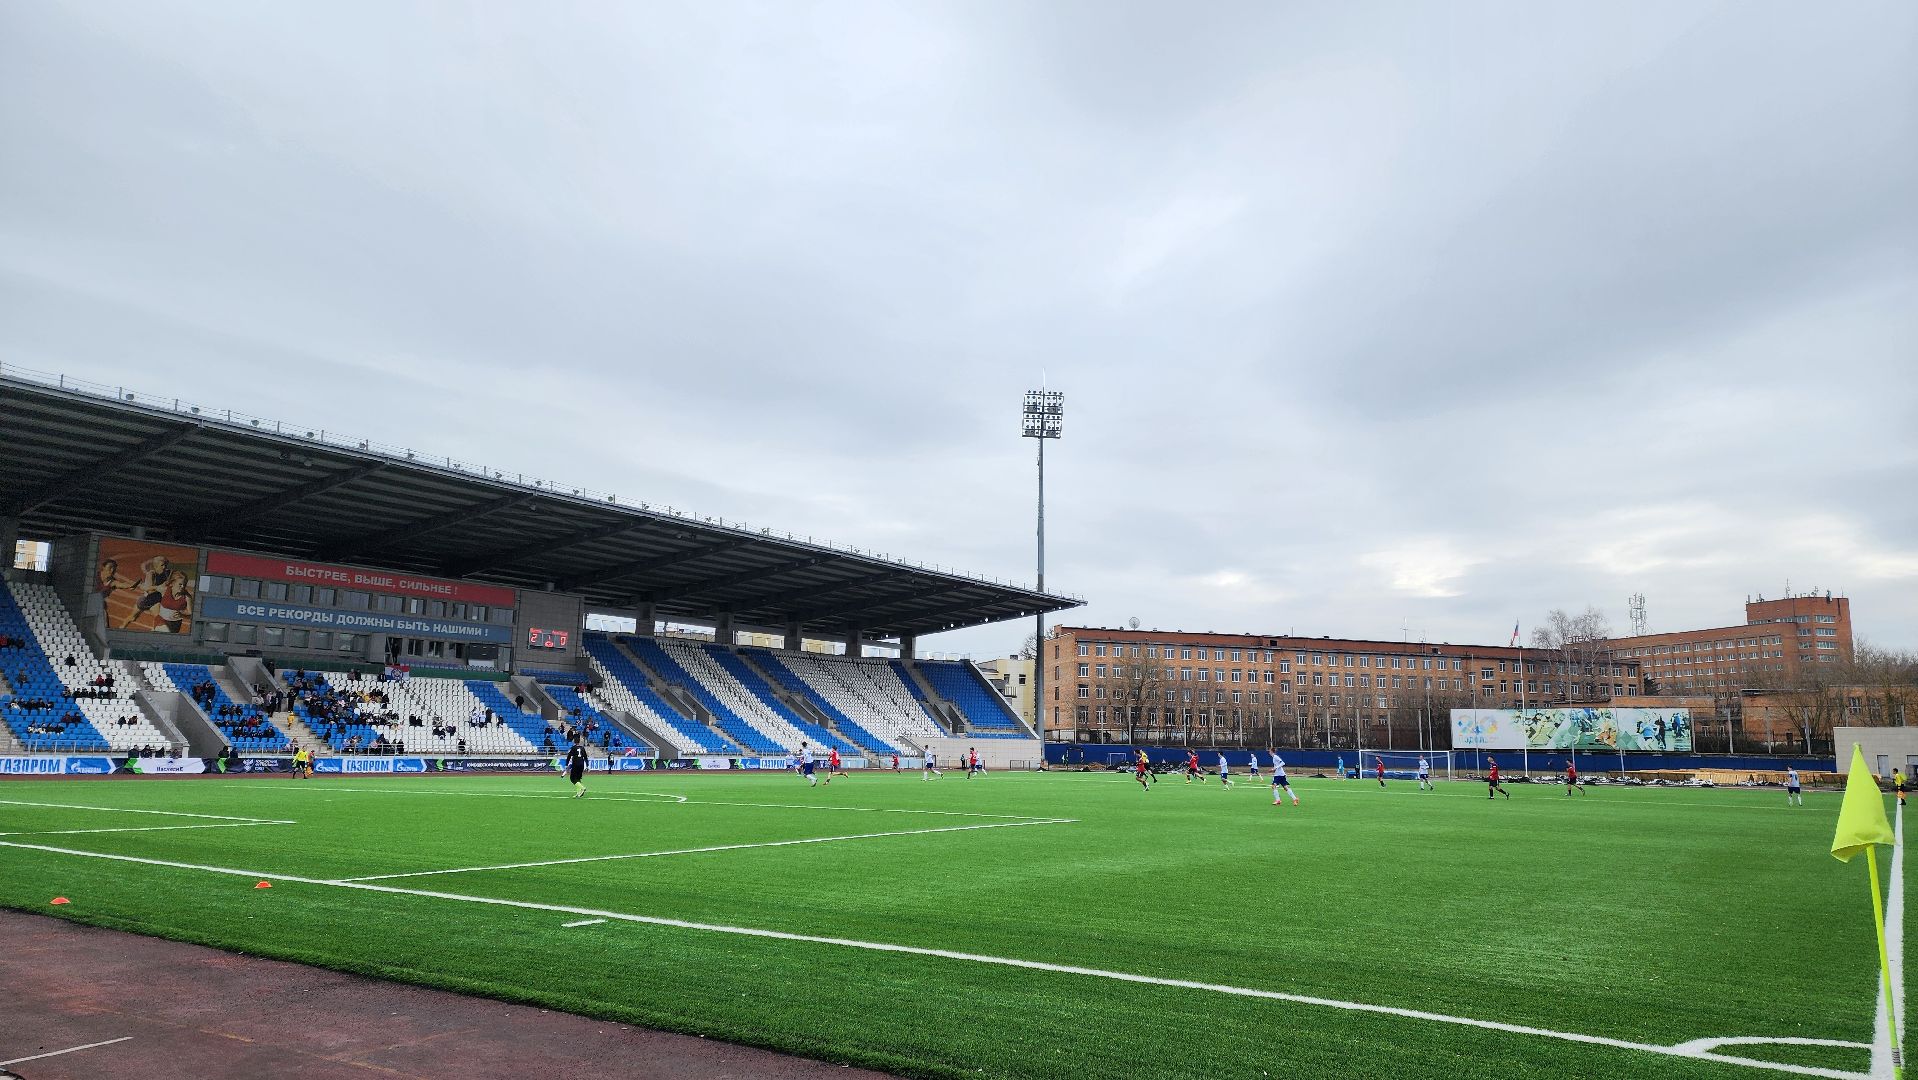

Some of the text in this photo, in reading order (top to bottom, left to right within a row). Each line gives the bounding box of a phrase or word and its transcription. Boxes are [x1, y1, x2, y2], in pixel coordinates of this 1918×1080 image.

[286, 565, 351, 584] БЫСТРЕЕ,
[354, 574, 396, 589] ВЫШЕ,
[399, 580, 451, 595] СИЛЬНЕЕ
[237, 604, 265, 617] ВСЕ
[268, 607, 333, 623] РЕКОРДЫ
[336, 614, 394, 628] ДОЛЖНЫ
[397, 620, 430, 631] БЫТЬ
[433, 623, 482, 636] НАШИМИ
[531, 633, 537, 642] 2
[560, 636, 566, 645] 0
[576, 748, 582, 758] 1
[346, 759, 390, 772] ГАЗПРОМ
